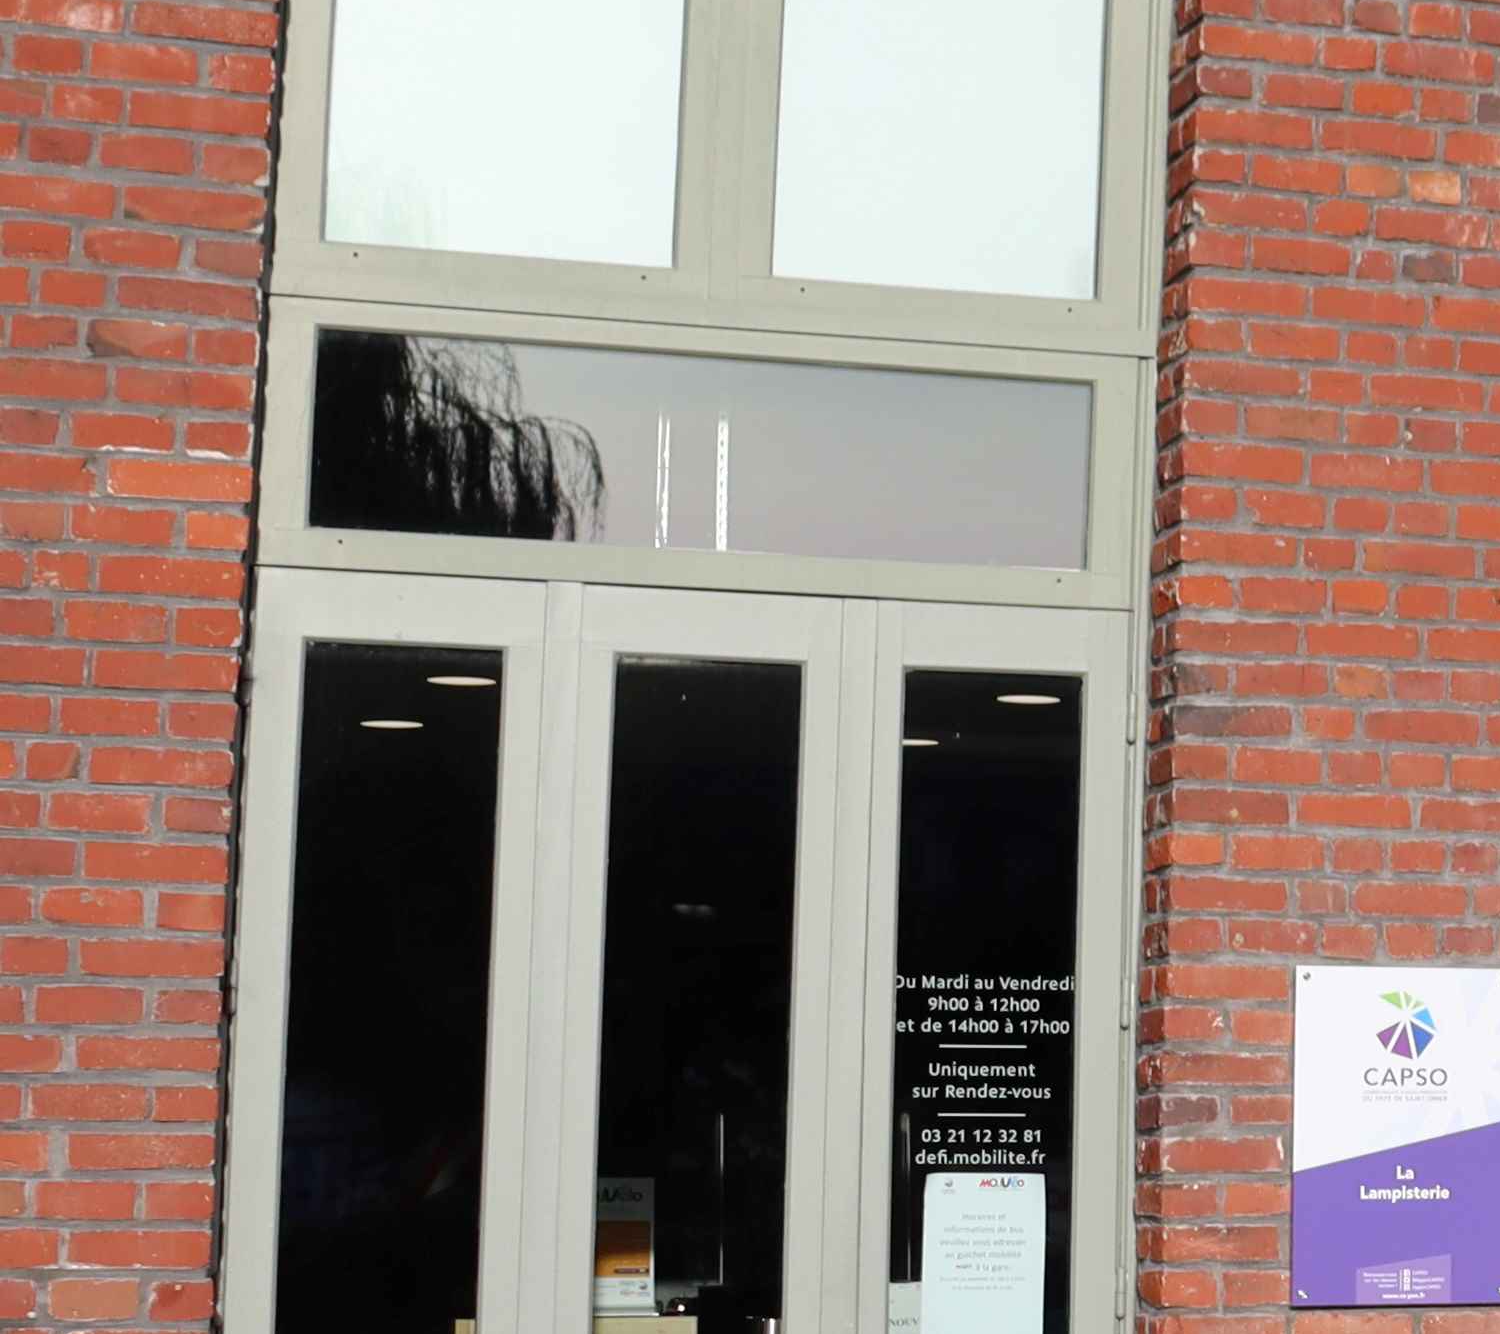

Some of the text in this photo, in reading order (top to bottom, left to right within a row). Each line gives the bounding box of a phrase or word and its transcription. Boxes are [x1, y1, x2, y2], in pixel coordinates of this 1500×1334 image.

[896, 974, 1075, 991] Du Mardi au Vendredi
[928, 996, 1040, 1012] 9h00 à 12h00
[896, 1018, 1070, 1034] et de 14h00 à 17h00
[929, 1061, 1036, 1080] Uniquement
[1363, 1067, 1448, 1087] CAPSO
[912, 1083, 1052, 1099] sur Rendez-vous
[921, 1129, 1042, 1143] 03 21 12 32 81
[915, 1149, 1046, 1165] defi.mobilite.fr
[1396, 1165, 1415, 1180] La
[1360, 1184, 1450, 1204] Lampisterie
